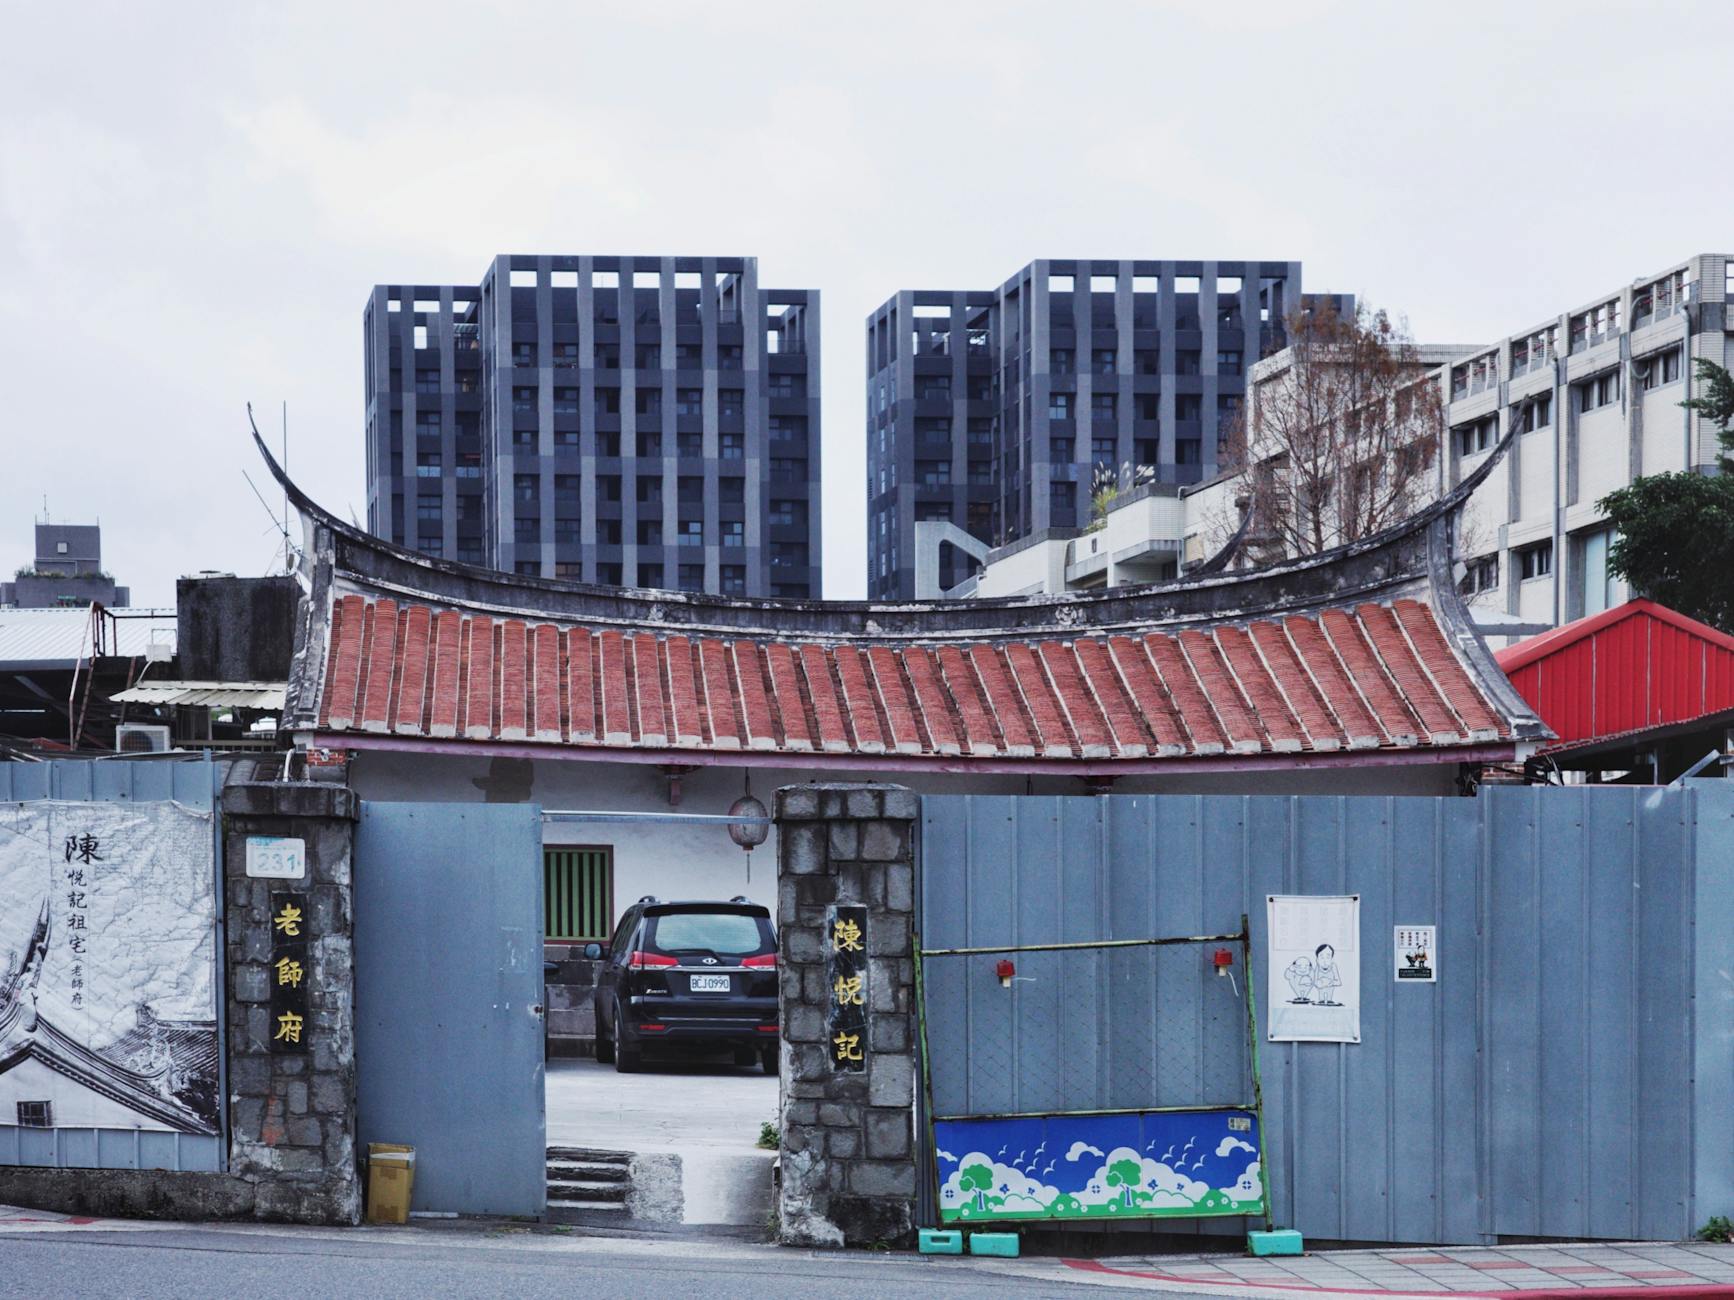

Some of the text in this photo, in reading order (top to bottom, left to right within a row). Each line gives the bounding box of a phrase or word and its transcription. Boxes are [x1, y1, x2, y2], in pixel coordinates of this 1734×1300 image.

[257, 852, 296, 873] 231
[274, 903, 303, 1043] 老師府
